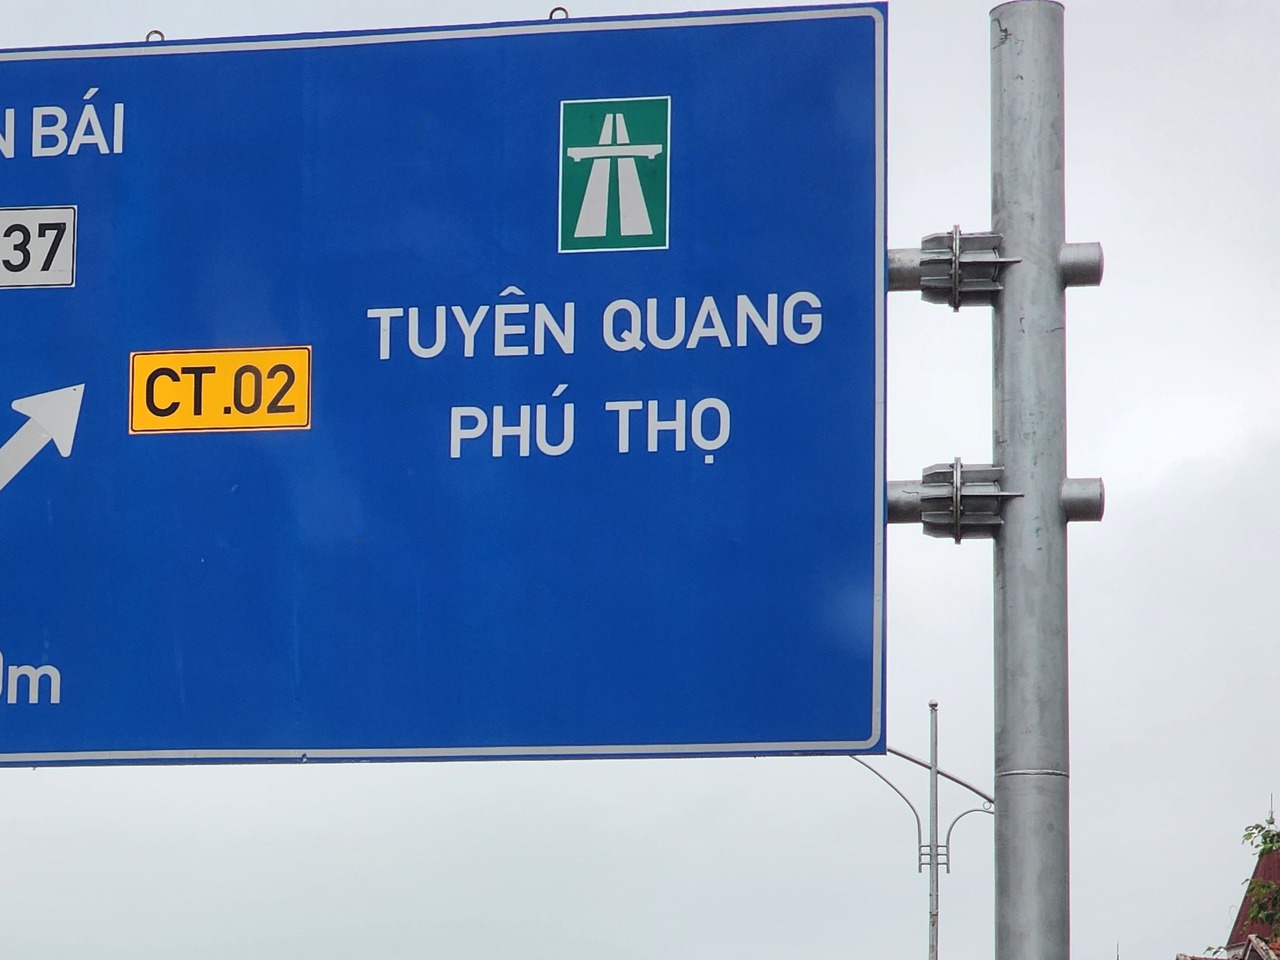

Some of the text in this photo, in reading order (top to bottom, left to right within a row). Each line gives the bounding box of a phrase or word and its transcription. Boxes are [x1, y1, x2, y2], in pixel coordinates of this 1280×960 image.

[32, 88, 125, 158] BÁI
[367, 285, 823, 360] TUYÊN QUANG
[145, 363, 297, 418] CT.02
[449, 384, 731, 464] PHÚ THỌ
